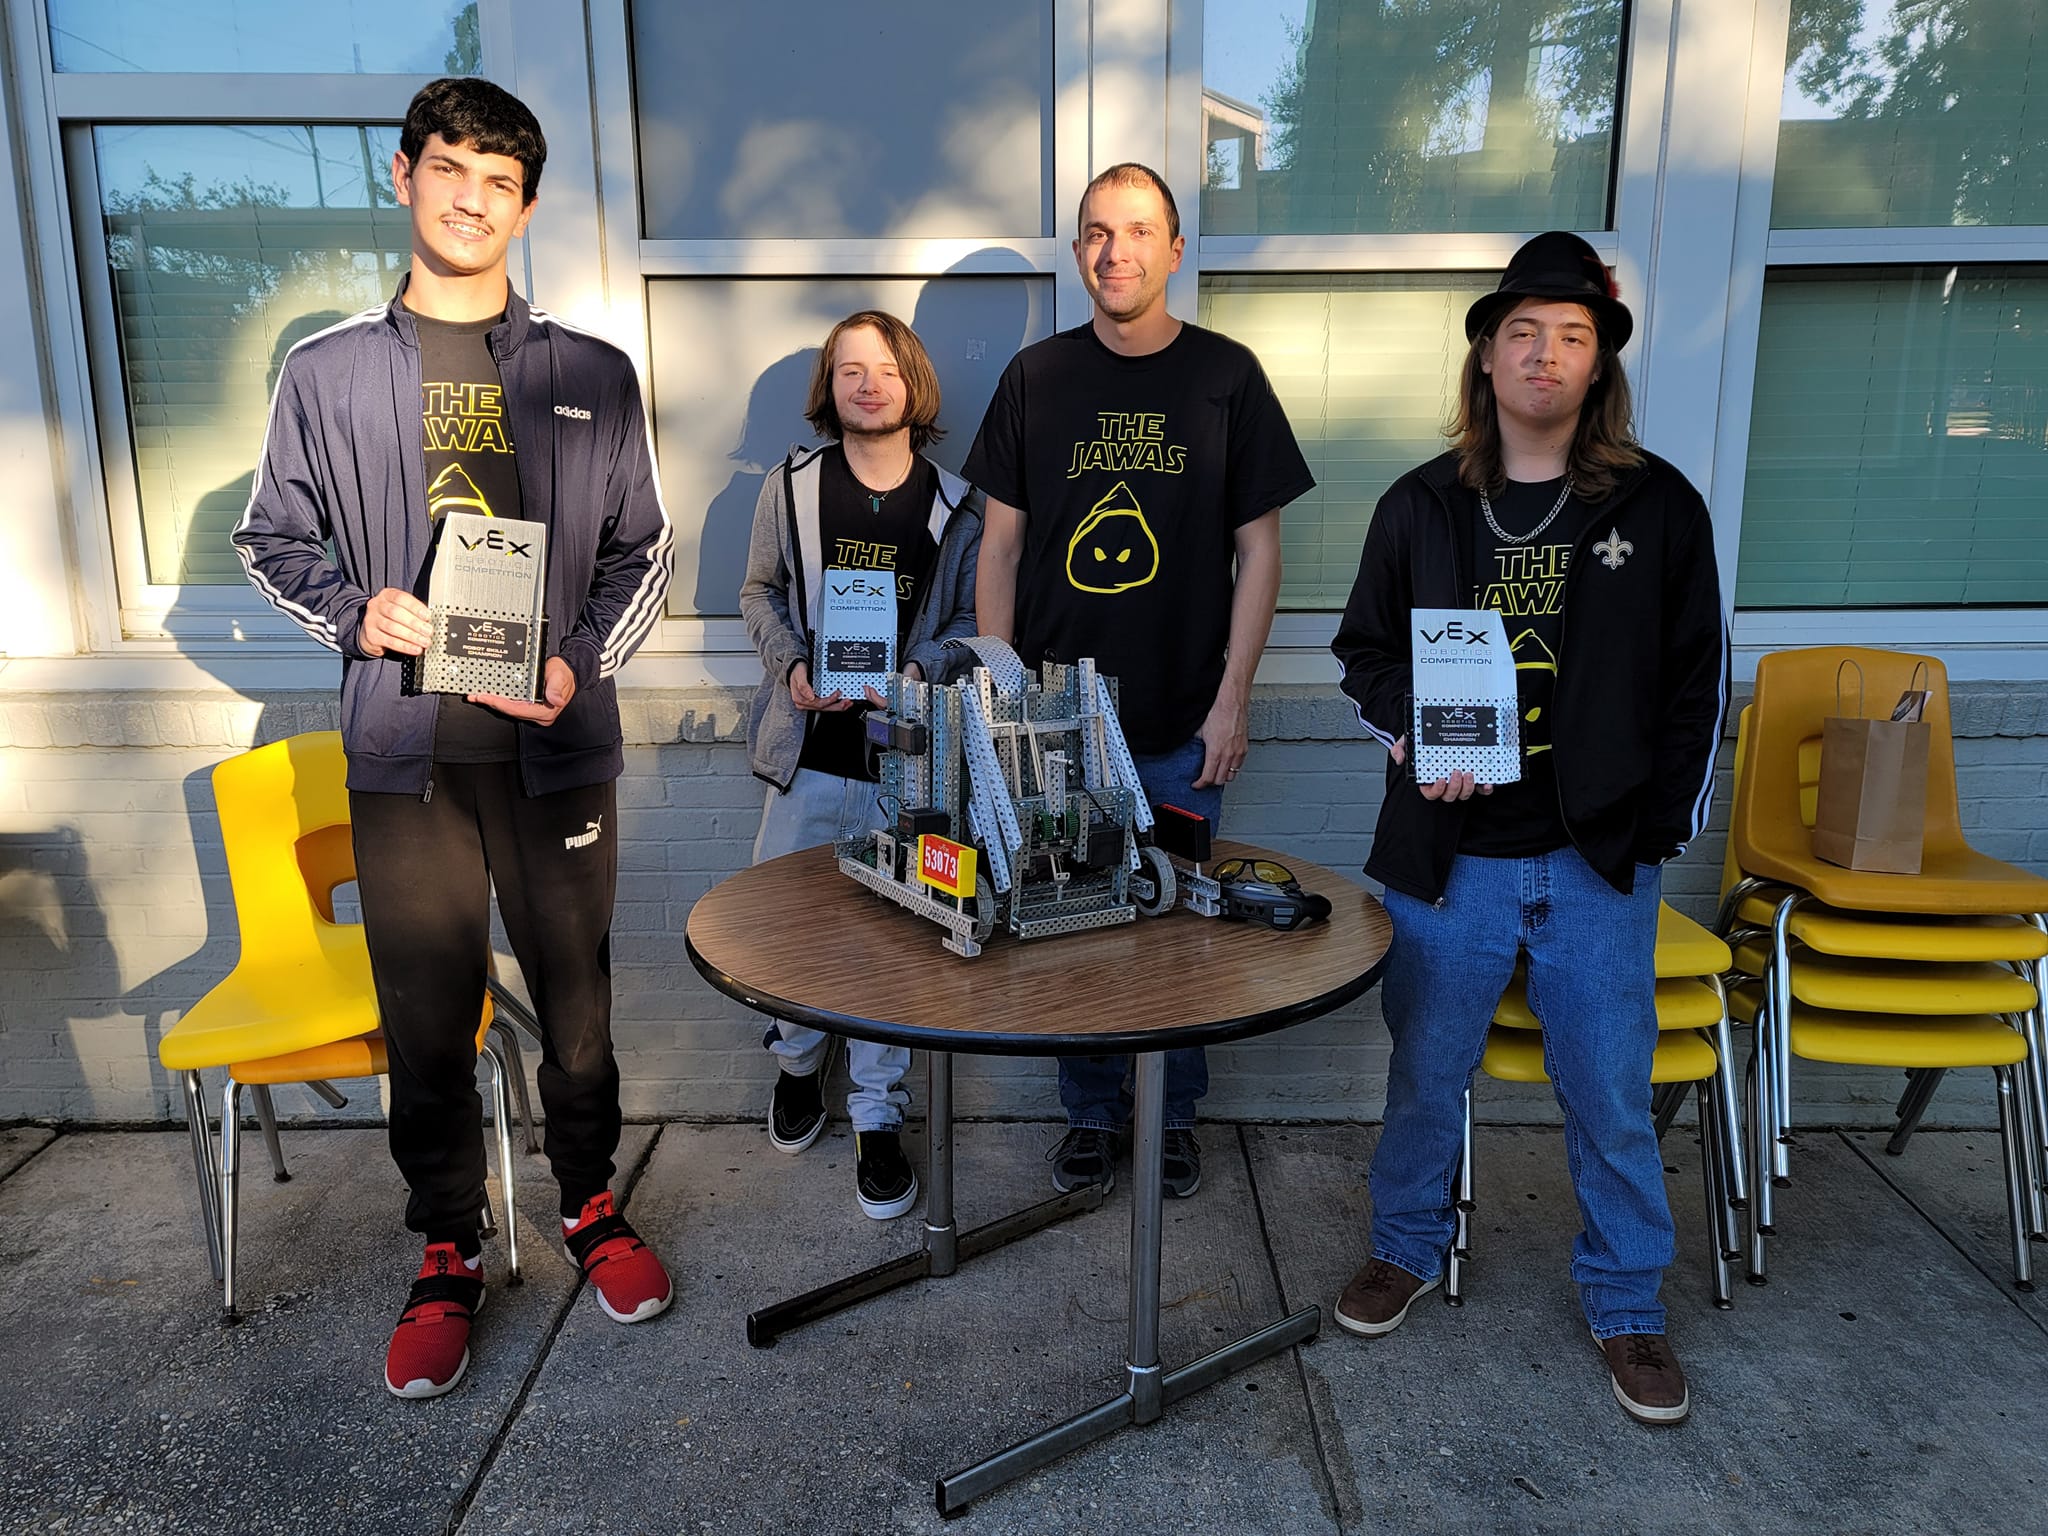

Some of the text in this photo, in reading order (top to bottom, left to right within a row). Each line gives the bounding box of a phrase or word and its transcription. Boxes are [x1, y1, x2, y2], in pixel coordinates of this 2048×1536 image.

[422, 382, 502, 417] THE
[553, 405, 592, 420] adidas
[1097, 412, 1166, 441] THE
[1066, 441, 1188, 479] JAWAS
[457, 529, 533, 559] VEX
[835, 538, 898, 571] THE
[454, 564, 533, 579] COMPETITION
[1494, 544, 1573, 579] THE
[831, 579, 886, 597] VEX
[468, 621, 506, 636] VEX
[1420, 621, 1491, 645] VEX
[843, 643, 870, 653] VEX
[1420, 657, 1492, 665] COMPETITION
[1441, 707, 1477, 720] VEX
[564, 828, 599, 850] PUMA
[924, 844, 957, 879] 53073
